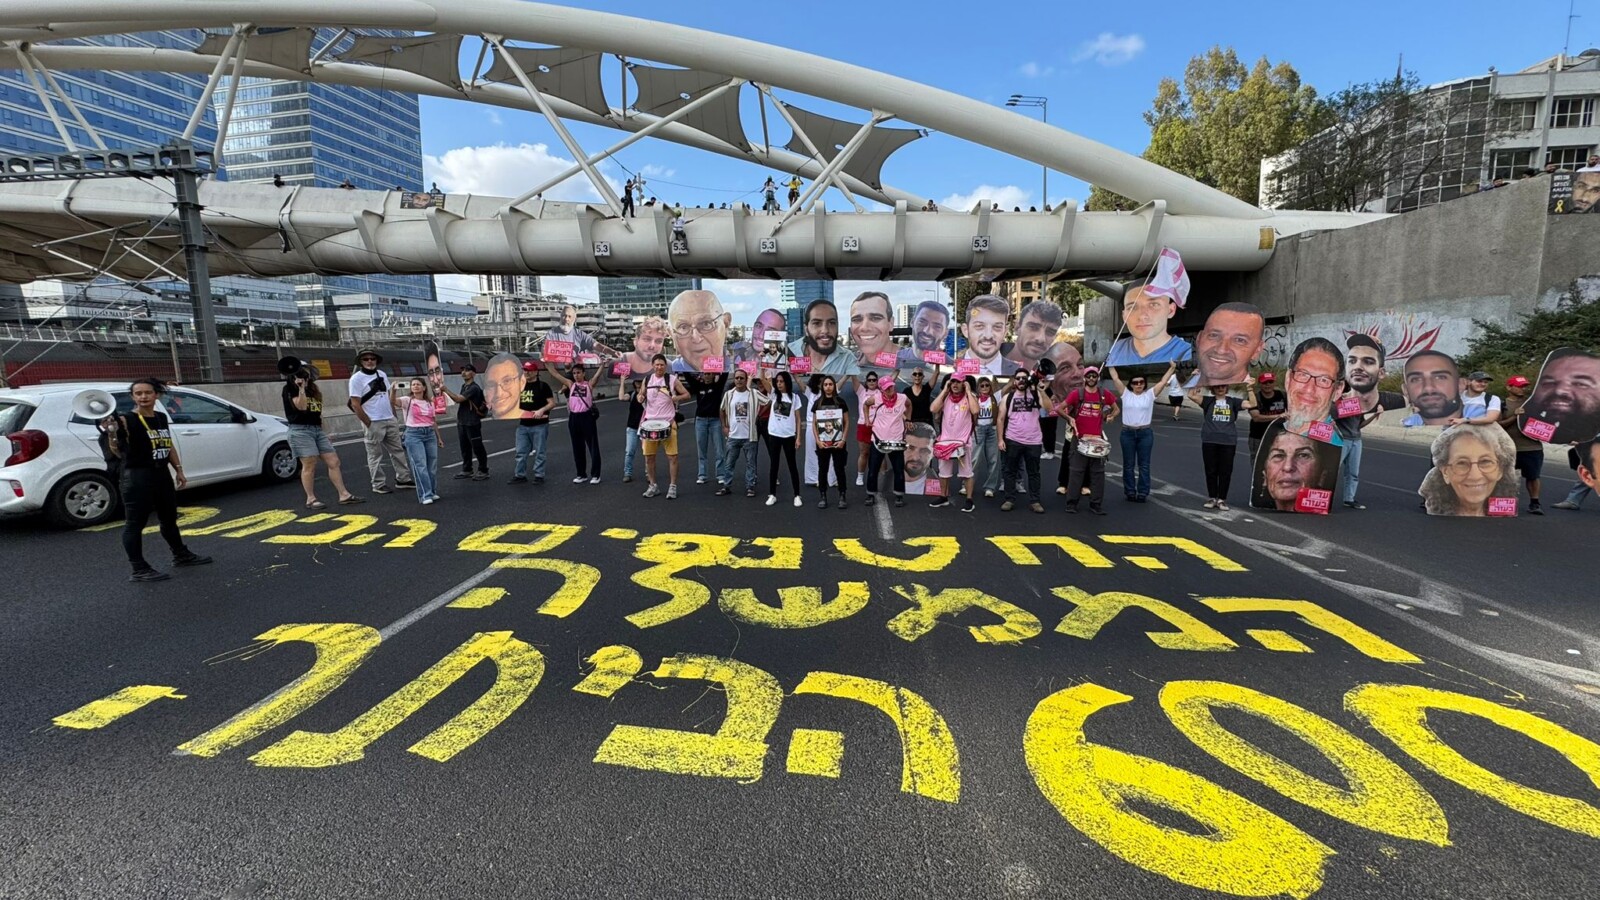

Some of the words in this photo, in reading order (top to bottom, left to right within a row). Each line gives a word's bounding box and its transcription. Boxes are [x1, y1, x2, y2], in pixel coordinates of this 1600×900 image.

[673, 243, 685, 251] 5.3
[761, 241, 775, 250] 5.3
[844, 239, 857, 248] 5.3
[974, 239, 988, 248] 5.3
[596, 244, 608, 253] 5.3
[1535, 421, 1554, 431] עדיין
[1309, 490, 1329, 499] עדיין
[446, 556, 1424, 664] הממשלה
[52, 621, 961, 803] הביתה
[1023, 680, 1600, 899] 600
